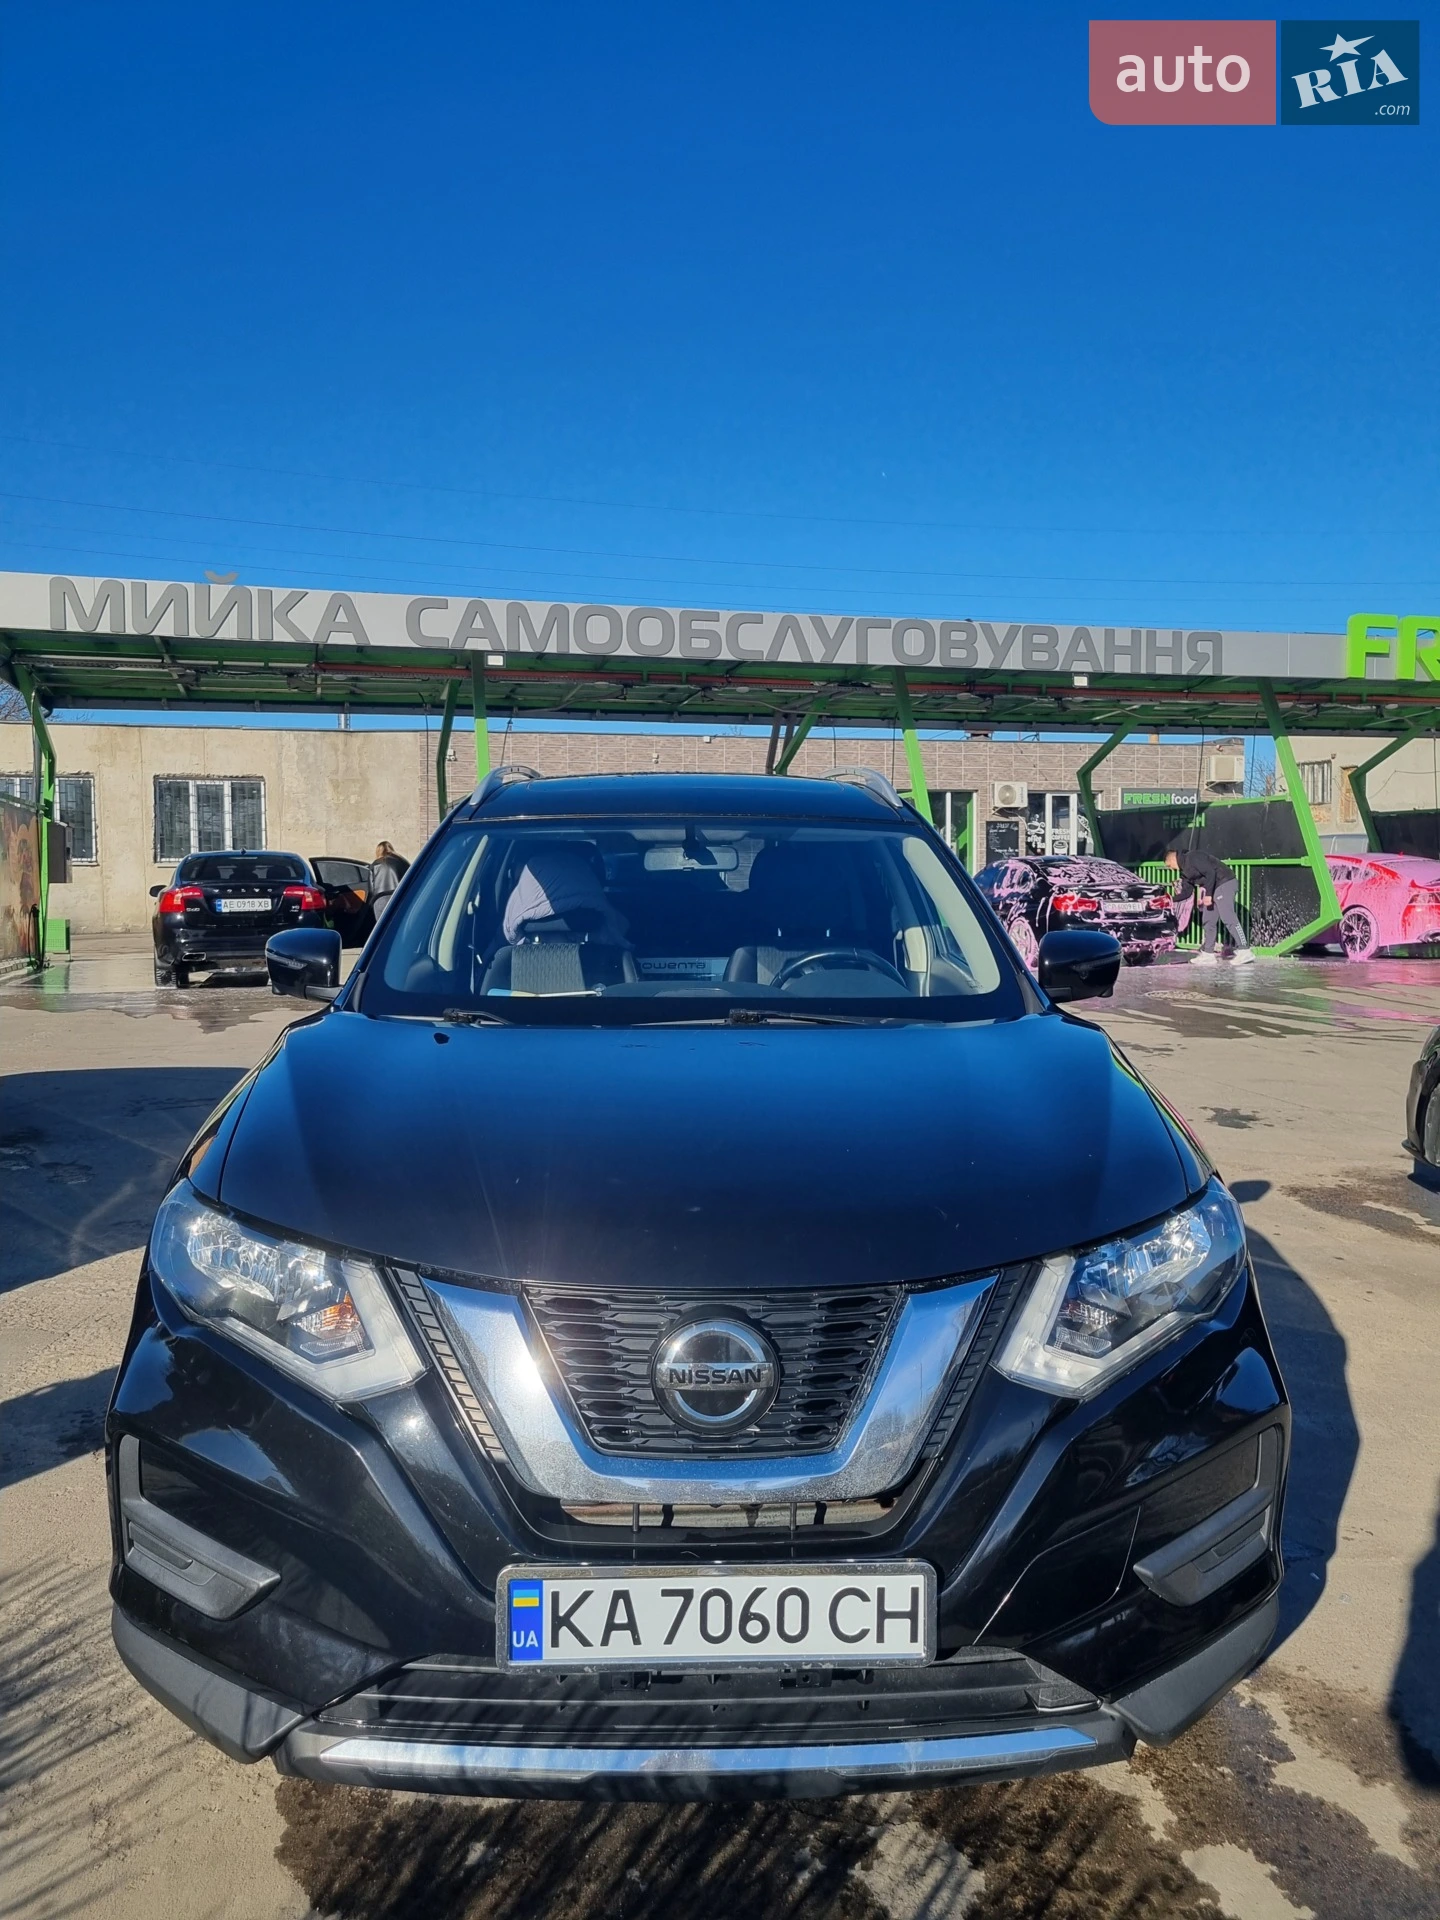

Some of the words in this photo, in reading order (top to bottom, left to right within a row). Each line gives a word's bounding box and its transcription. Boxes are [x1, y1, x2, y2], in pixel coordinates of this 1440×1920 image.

[49, 571, 371, 644] МИЙКА
[406, 596, 1223, 676] САМООБСЛУГОВУВАННЯ
[223, 901, 234, 909] AE
[236, 900, 256, 909] 0918
[669, 1368, 762, 1384] NISSAN
[550, 1588, 642, 1648] KA
[660, 1587, 810, 1646] 7060
[828, 1586, 919, 1645] CH
[512, 1631, 538, 1648] UA
